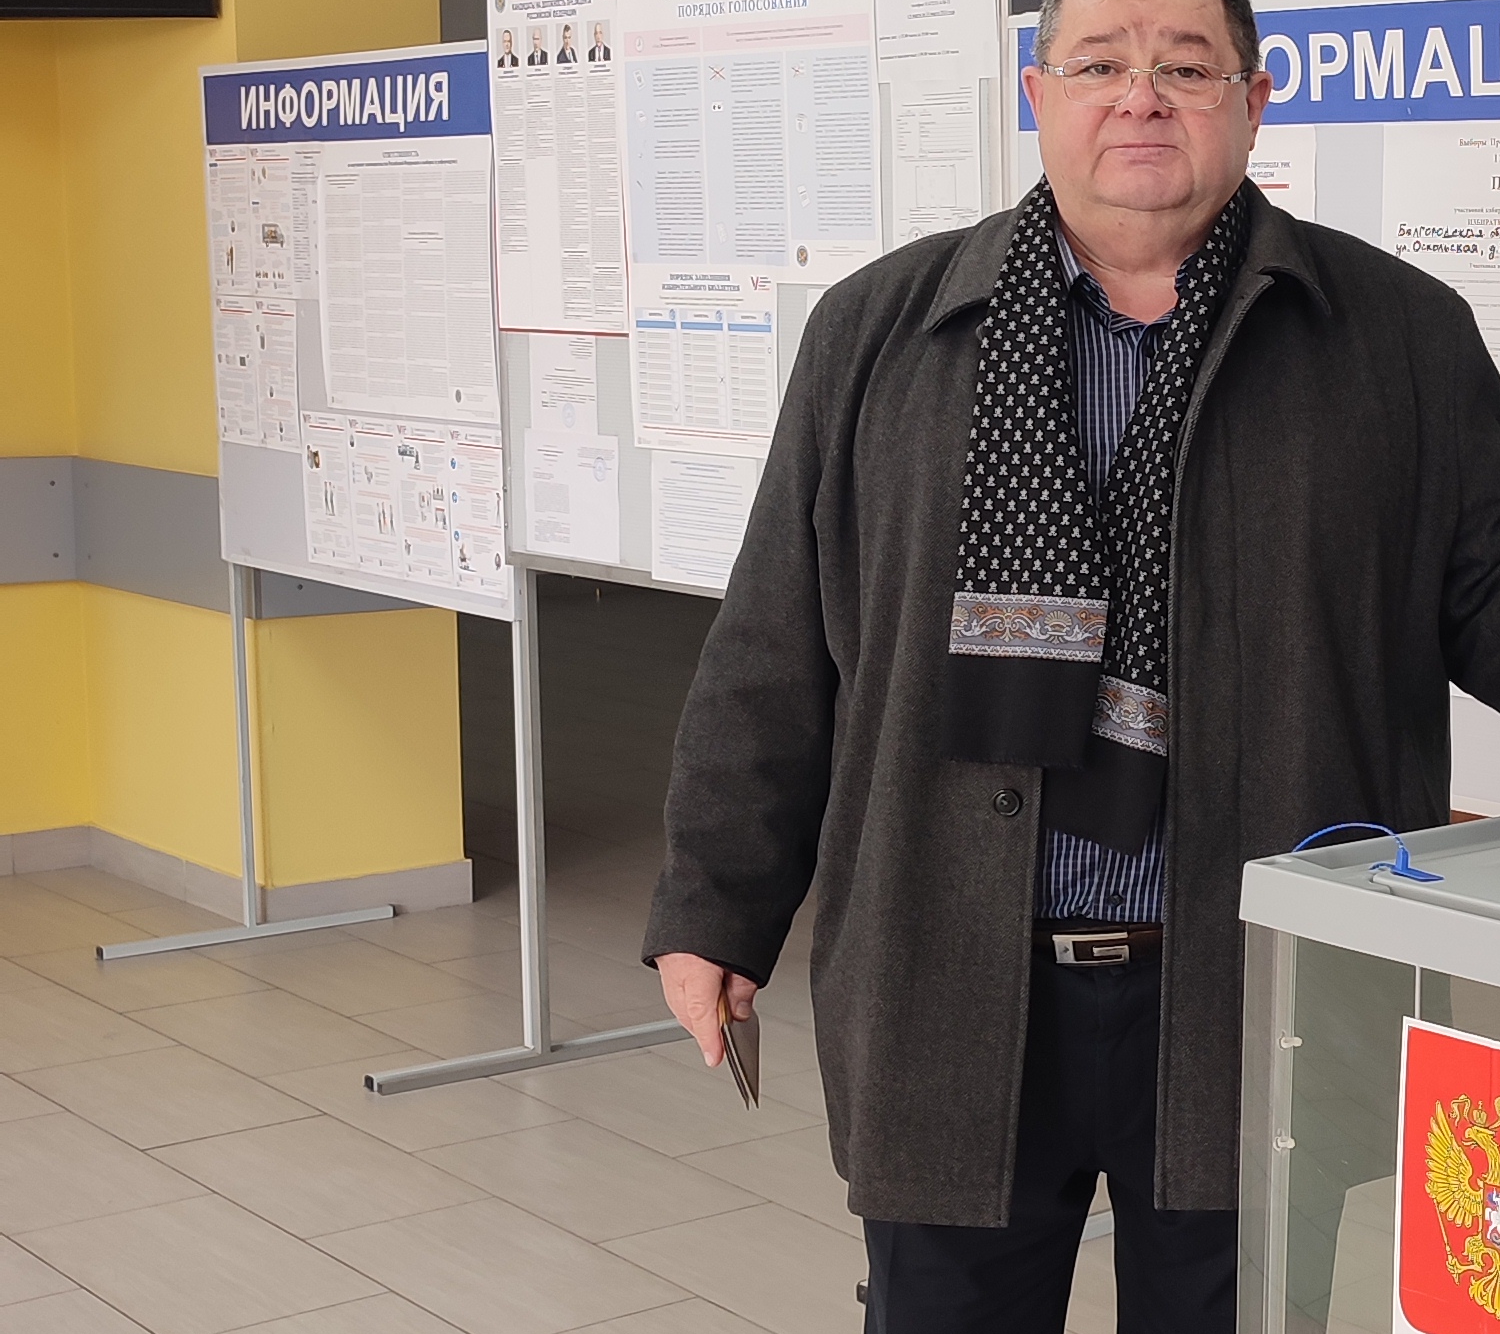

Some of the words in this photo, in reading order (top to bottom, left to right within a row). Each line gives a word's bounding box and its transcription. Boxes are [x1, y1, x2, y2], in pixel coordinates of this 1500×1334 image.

[677, 0, 726, 18] ПОРЯДОК
[240, 71, 449, 133] ИНФОРМАЦИЯ
[1458, 137, 1487, 148] Выборы
